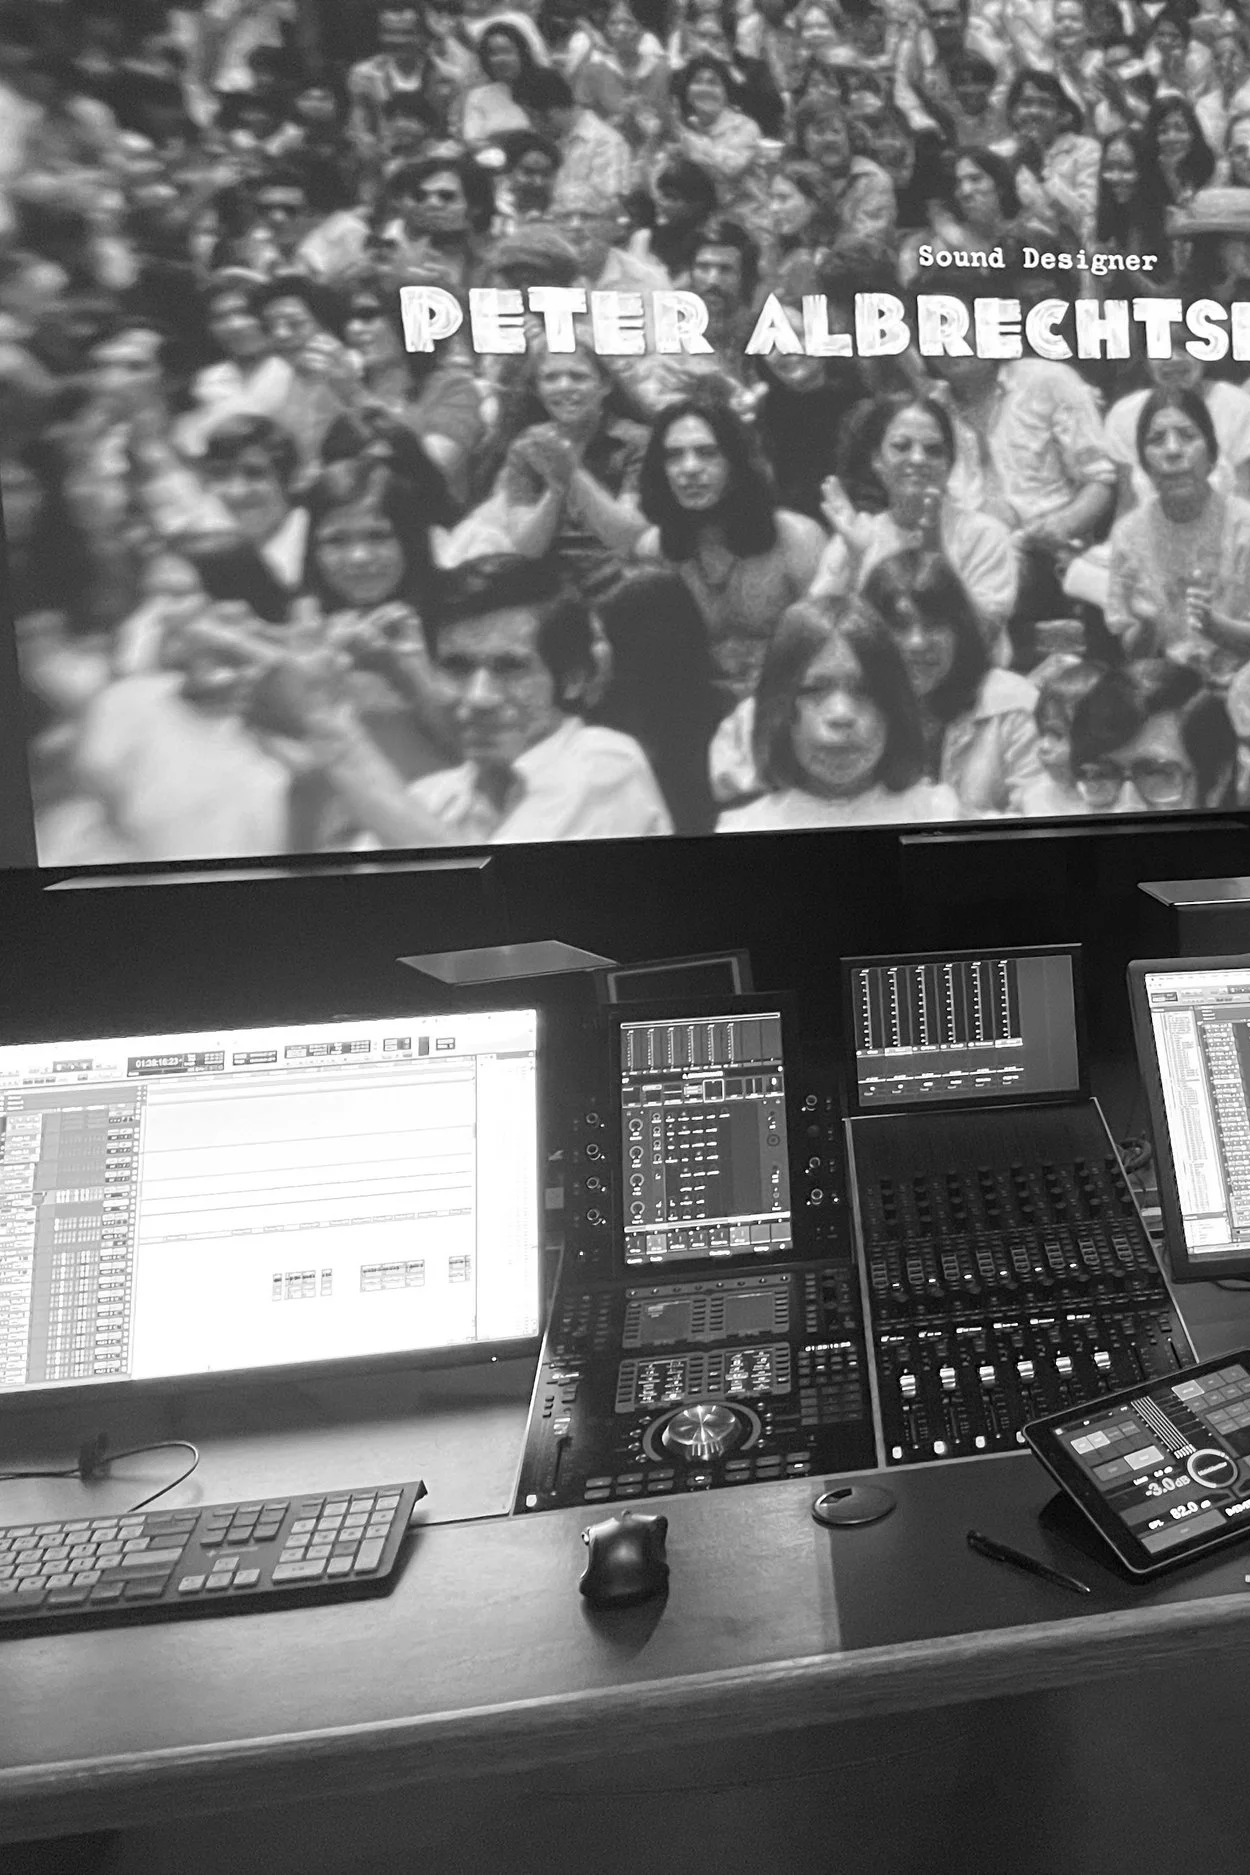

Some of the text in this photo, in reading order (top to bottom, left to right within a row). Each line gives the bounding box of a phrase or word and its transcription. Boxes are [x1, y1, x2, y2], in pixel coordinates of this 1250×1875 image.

[918, 245, 1159, 275] Sound Designer
[399, 285, 715, 355] PETER
